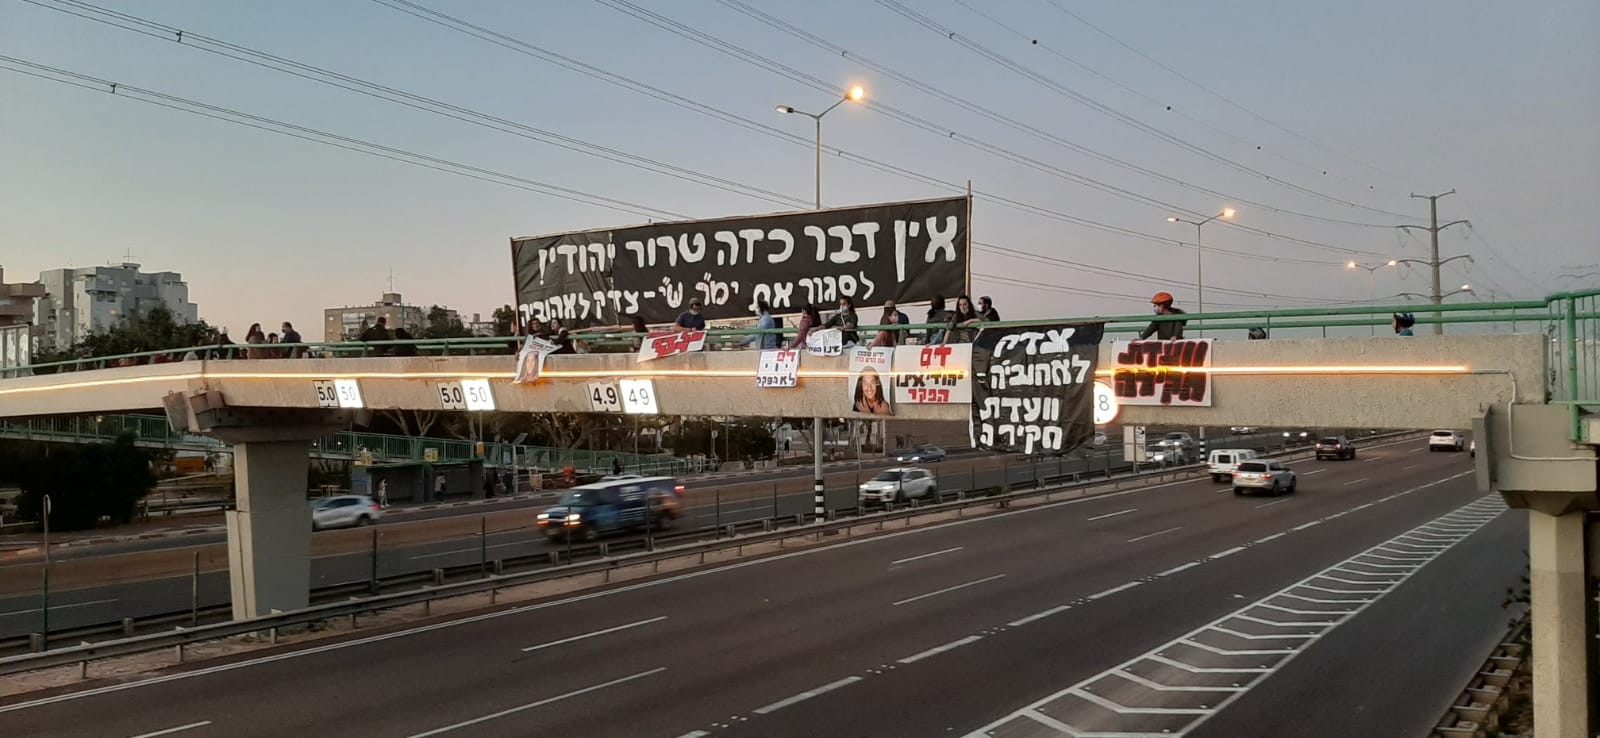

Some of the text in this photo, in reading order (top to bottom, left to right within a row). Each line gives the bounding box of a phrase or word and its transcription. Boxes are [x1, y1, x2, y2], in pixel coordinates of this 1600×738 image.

[625, 232, 707, 269] טרור
[714, 227, 795, 266] כזה
[803, 221, 880, 264] דבר
[894, 215, 958, 283] אין
[748, 282, 793, 312] את
[798, 271, 875, 304] לסגור
[593, 290, 640, 320] צדק
[993, 328, 1076, 358] צדק
[1118, 341, 1209, 368] וועדת
[777, 351, 796, 362] דם
[920, 346, 952, 368] דם
[779, 372, 796, 385] לא
[896, 371, 964, 387] יהודי אינו
[1114, 369, 1207, 405] חקירה
[317, 386, 335, 401] 5.0
[441, 387, 462, 403] 5.0
[469, 386, 487, 402] 50
[593, 387, 617, 405] 4.9
[628, 388, 649, 406] 49
[908, 388, 950, 403] הפקר
[979, 397, 1060, 423] וועדת
[980, 423, 1063, 455] חקירה
